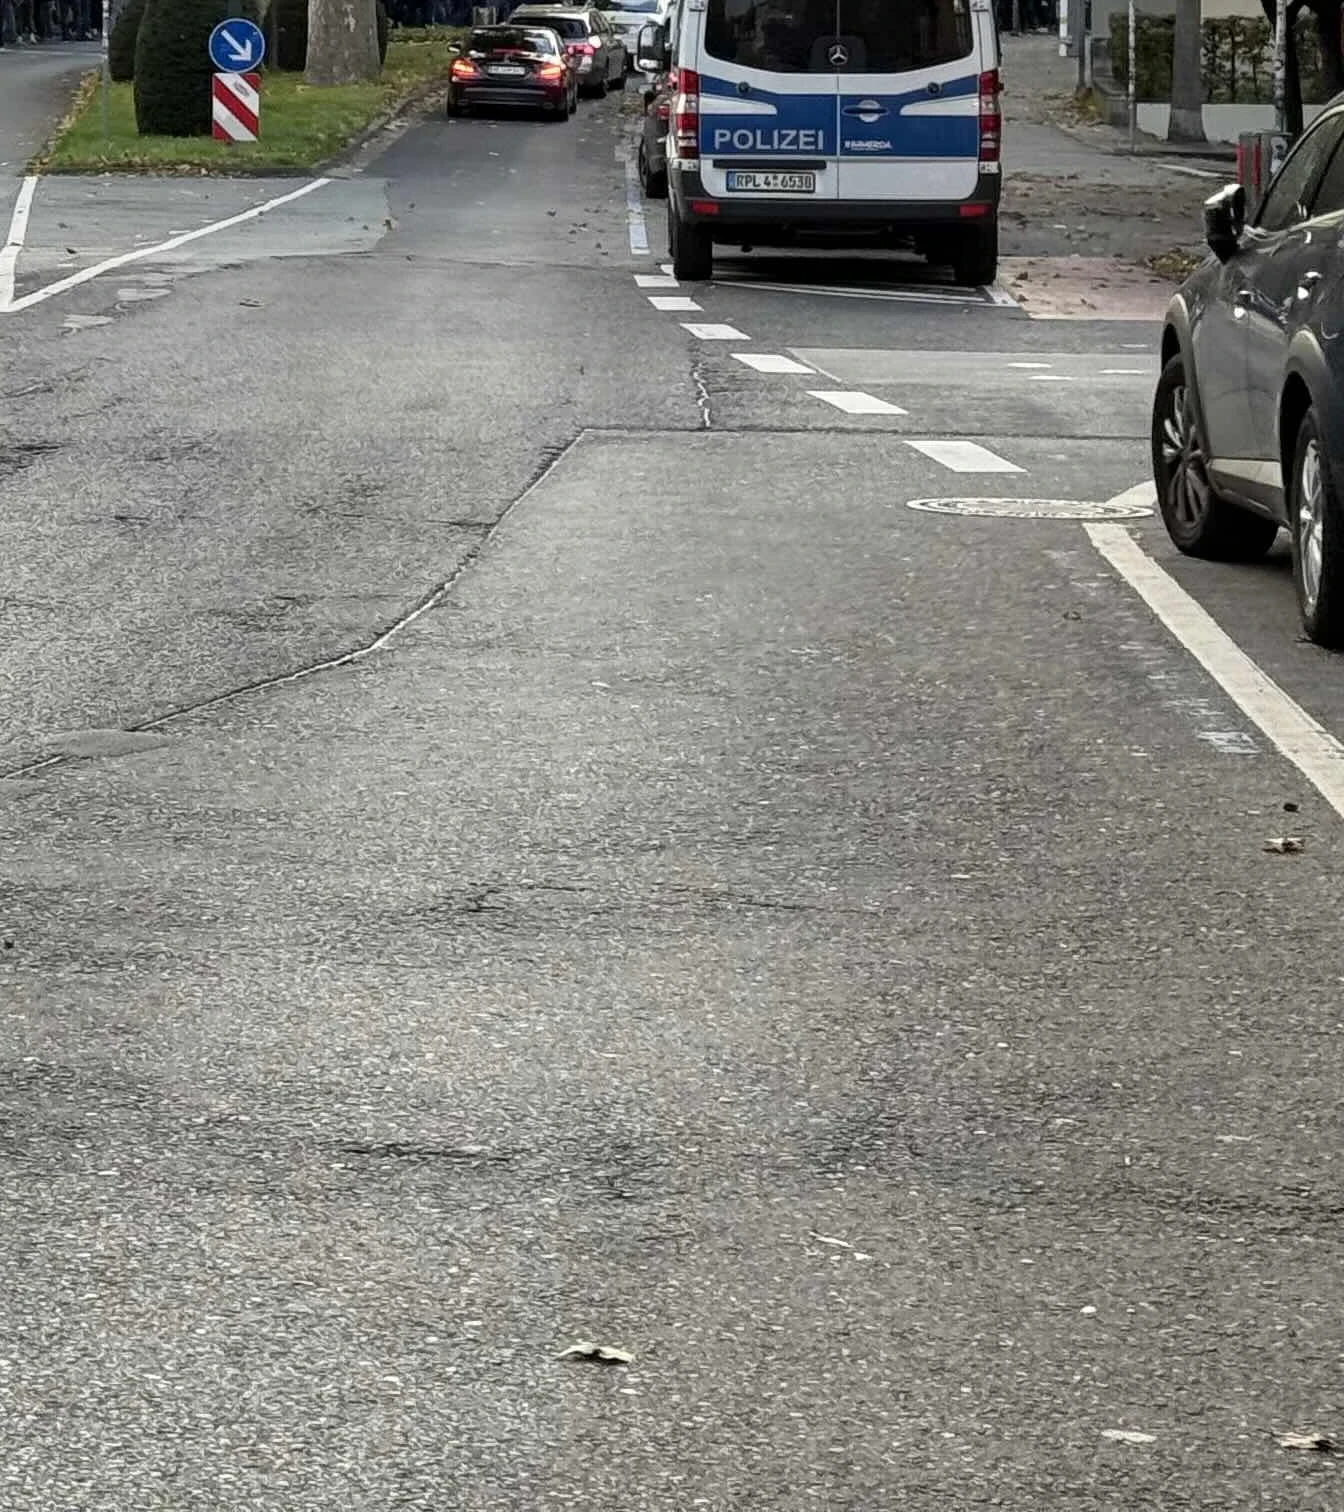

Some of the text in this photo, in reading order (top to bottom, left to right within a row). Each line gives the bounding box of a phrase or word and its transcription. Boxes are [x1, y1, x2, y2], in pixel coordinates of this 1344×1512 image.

[714, 129, 824, 150] POLIZEI
[736, 174, 761, 188] RPL
[763, 174, 772, 187] 4
